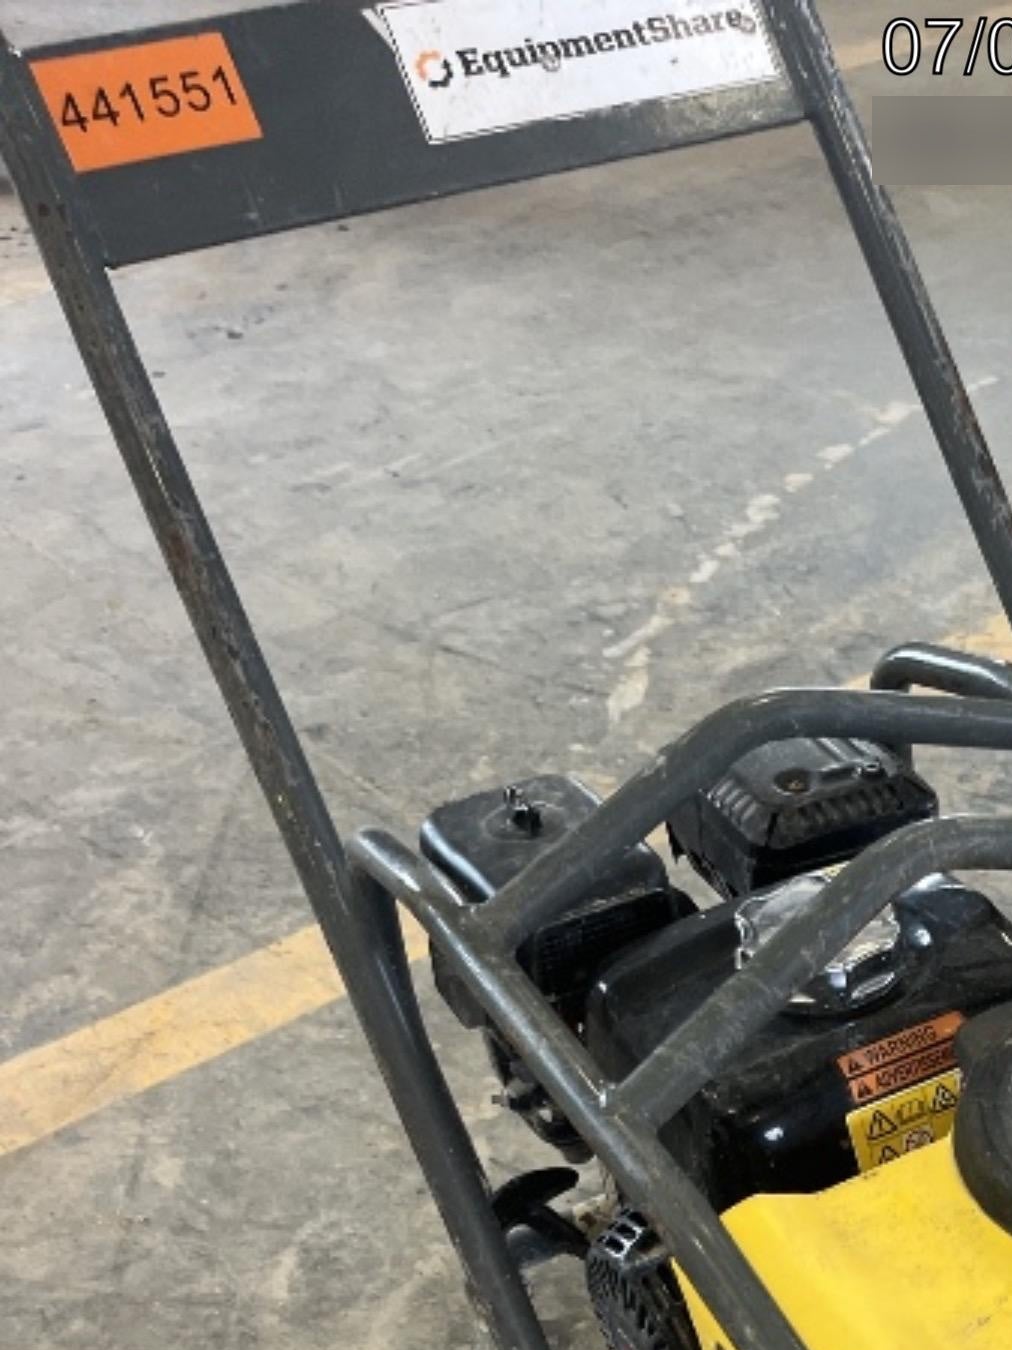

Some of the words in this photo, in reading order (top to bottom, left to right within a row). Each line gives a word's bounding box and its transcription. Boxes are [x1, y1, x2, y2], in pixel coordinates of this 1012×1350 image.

[456, 8, 745, 78] EquipmentShare
[61, 65, 237, 133] 441551
[864, 1025, 937, 1064] WARNING
